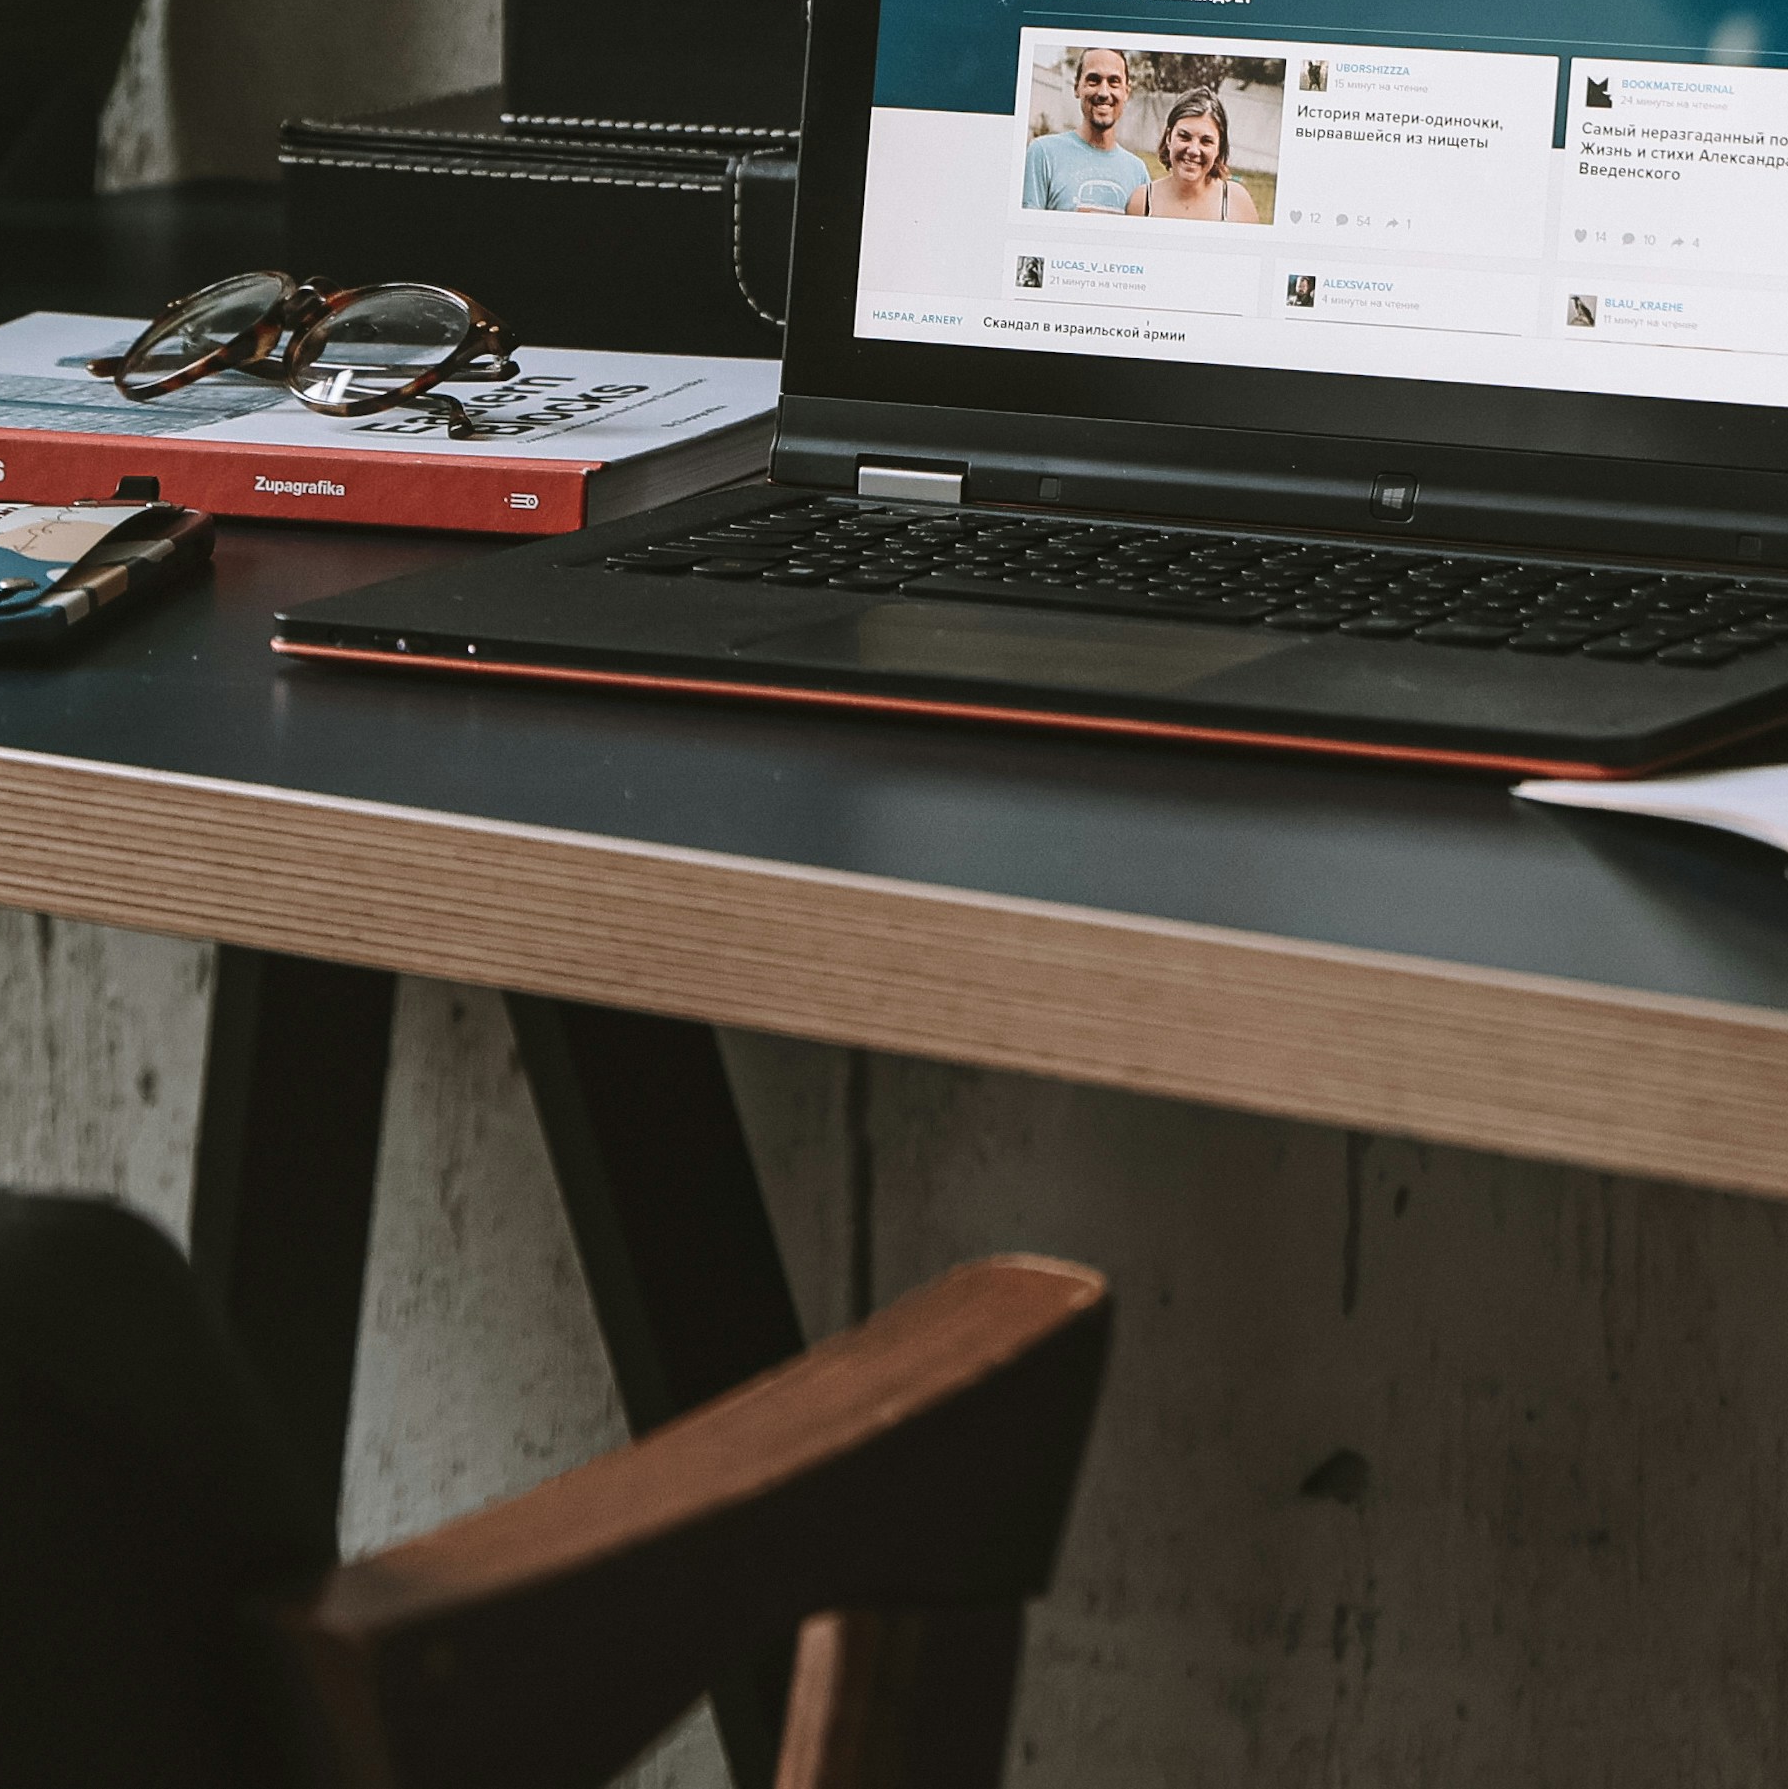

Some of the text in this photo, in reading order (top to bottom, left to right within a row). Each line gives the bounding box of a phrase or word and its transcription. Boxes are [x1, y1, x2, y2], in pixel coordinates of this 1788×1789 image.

[1336, 63, 1410, 76] UBORSHIZZZA
[1335, 79, 1344, 89] 15
[1347, 81, 1375, 91] минут
[1393, 85, 1428, 94] чтение
[1622, 79, 1734, 95] BOOKMATEJOURNAL
[1620, 95, 1729, 111] 24 минуты на чтение
[1297, 105, 1504, 131] История матери-одиночки,
[1296, 126, 1489, 150] вырвавшейся из нищеты
[1582, 122, 1636, 137] Самый
[1641, 127, 1765, 146] неразгаданный
[1580, 141, 1632, 157] Жизнь
[1637, 147, 1646, 158] и
[1651, 149, 1694, 161] стихи
[1579, 162, 1681, 181] Введенского
[1310, 212, 1321, 224] 12
[1356, 215, 1371, 227] 54
[1595, 231, 1606, 241] 14
[1644, 234, 1656, 245] 10
[1051, 260, 1144, 275] LUCAS_V_LEYDEN
[1049, 275, 1147, 292] 21 минута на чтение
[1323, 279, 1394, 292] ALEXSVATOV
[1331, 297, 1367, 308] минуты
[1370, 300, 1382, 308] на
[1385, 301, 1420, 310] чтение
[1605, 298, 1684, 313] BLAU_KRAEHE
[872, 310, 963, 326] HASPAR_ARNERY
[1614, 317, 1644, 327] минут
[1647, 319, 1659, 327] на
[983, 316, 1186, 342] Скандал в израильской армии
[254, 475, 345, 496] Zupagrafika
